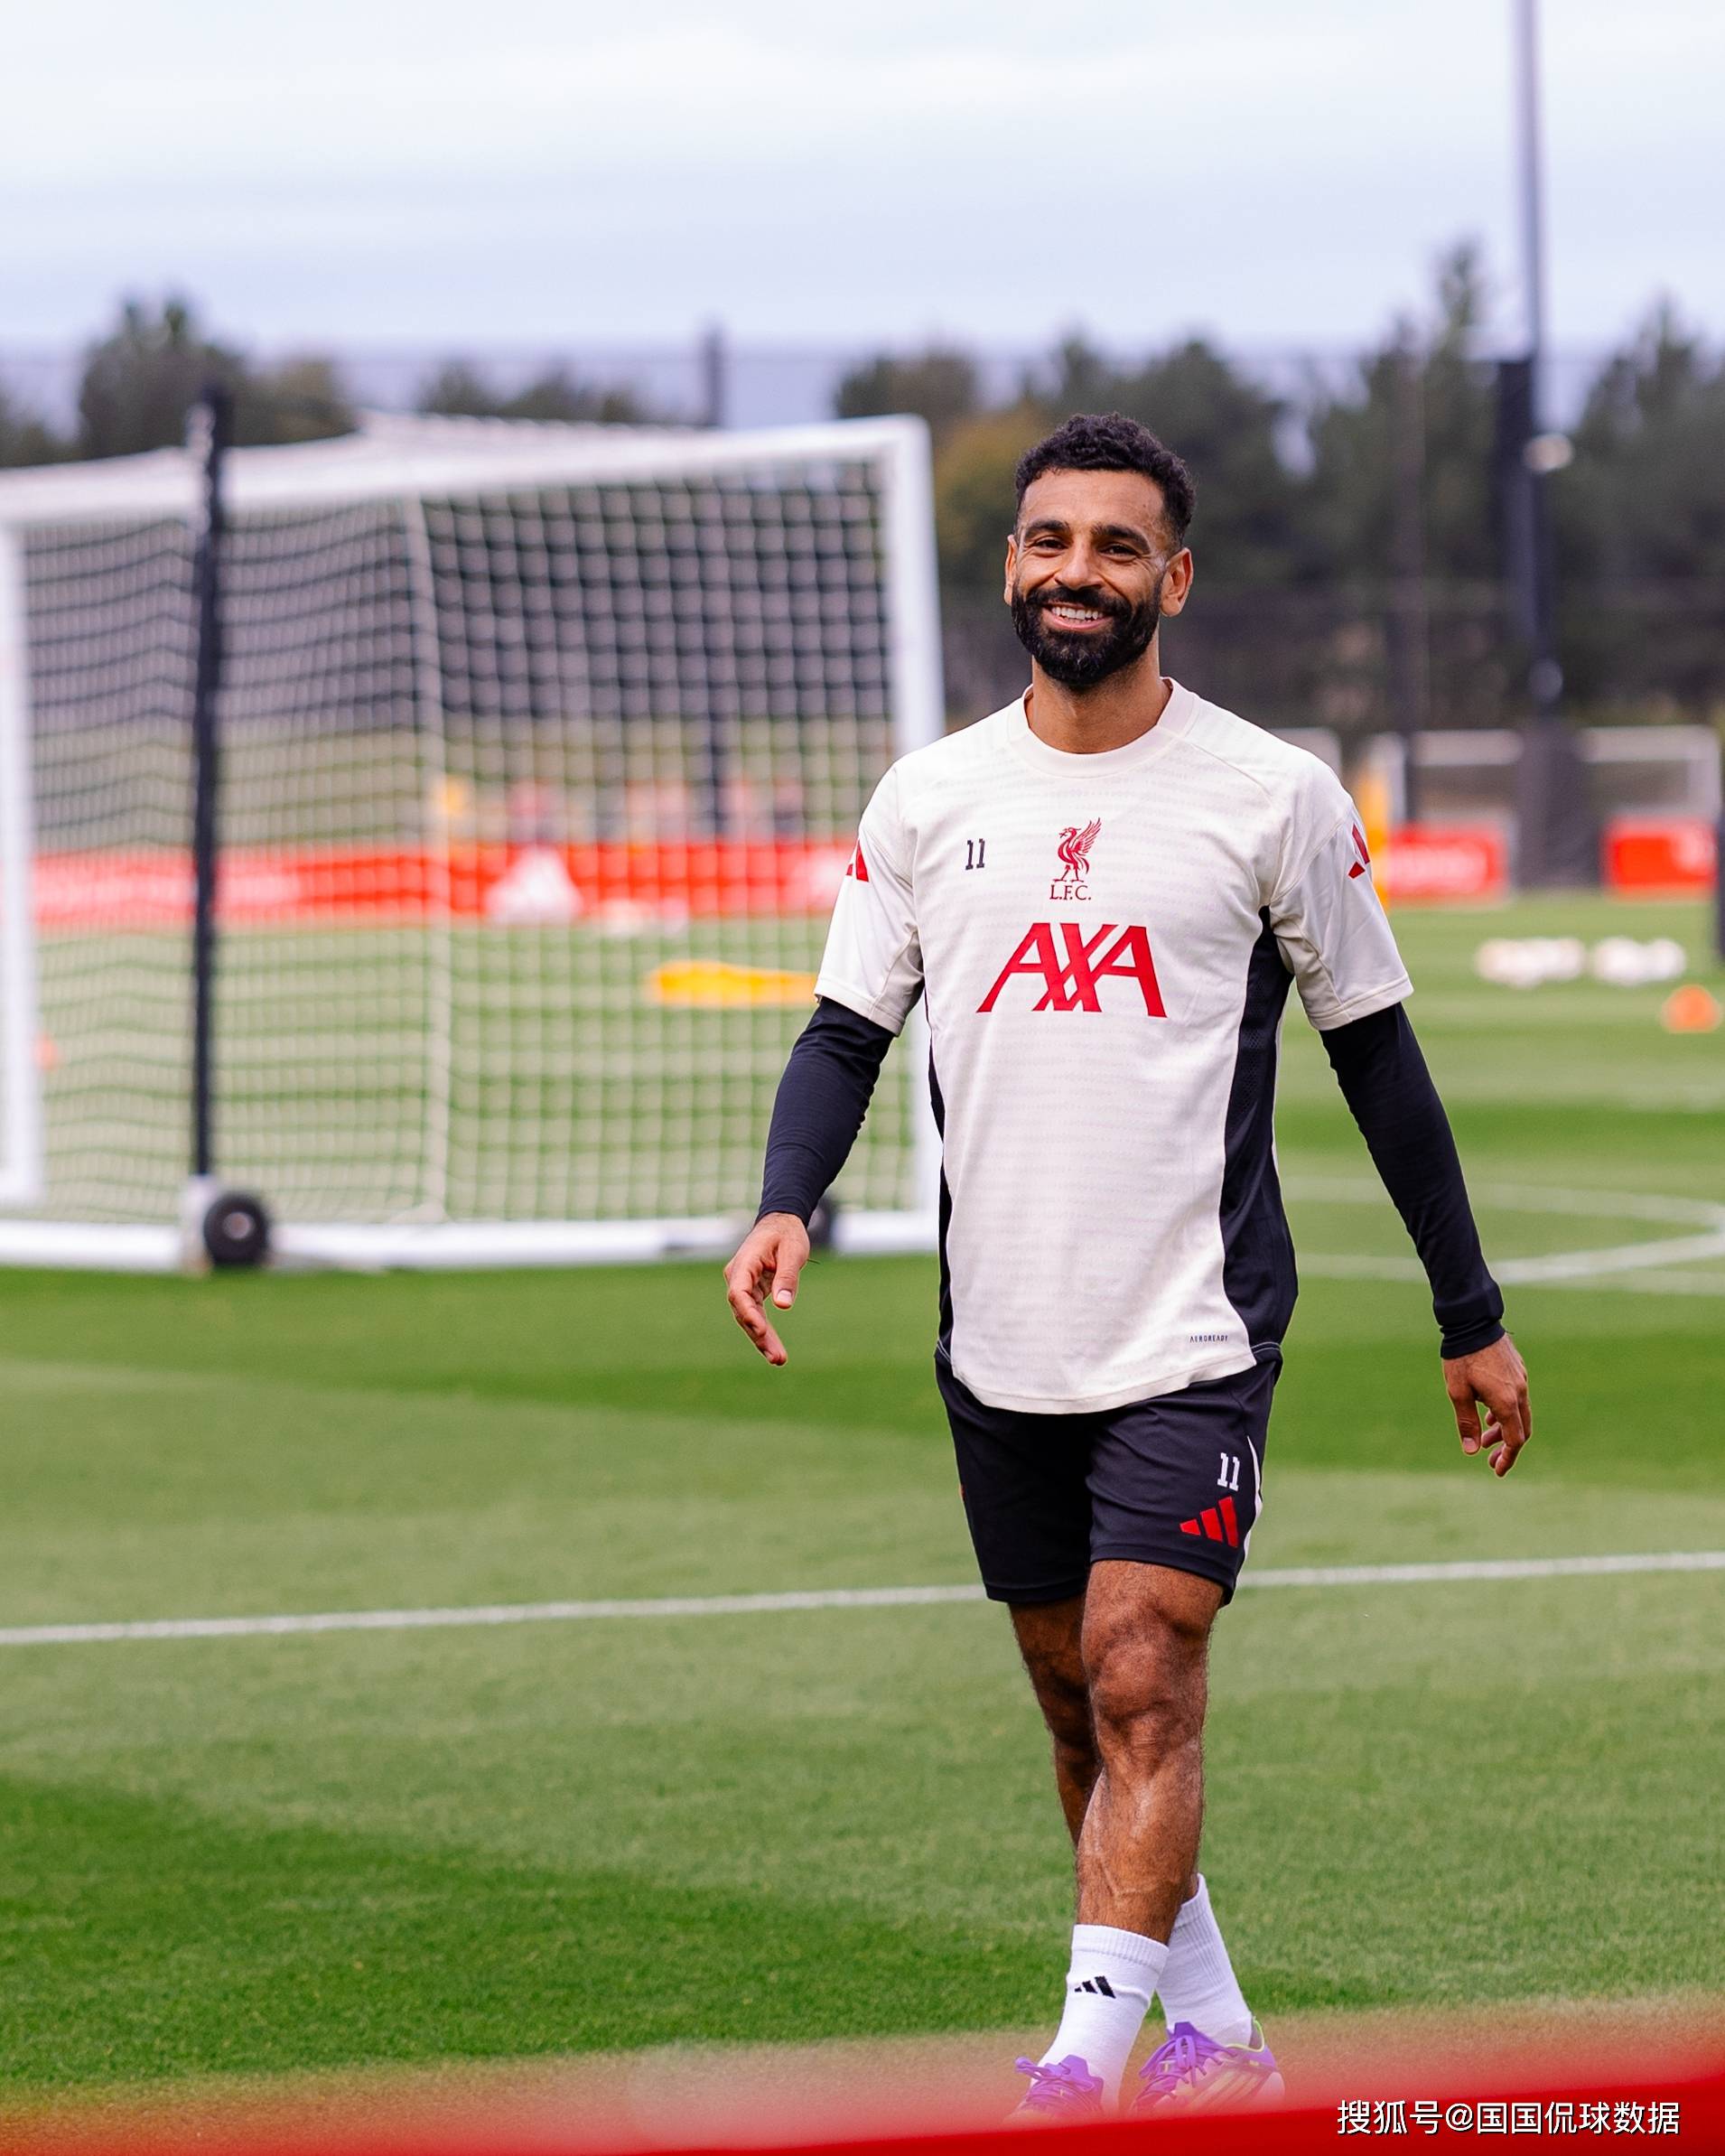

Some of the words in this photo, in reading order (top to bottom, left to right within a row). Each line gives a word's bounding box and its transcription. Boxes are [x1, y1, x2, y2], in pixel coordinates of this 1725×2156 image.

[965, 838, 985, 870] 11
[1049, 884, 1092, 901] L.F.C.
[976, 922, 1168, 1018] AXA
[1190, 1335, 1228, 1343] AEROREADY
[1217, 1452, 1240, 1491] 11
